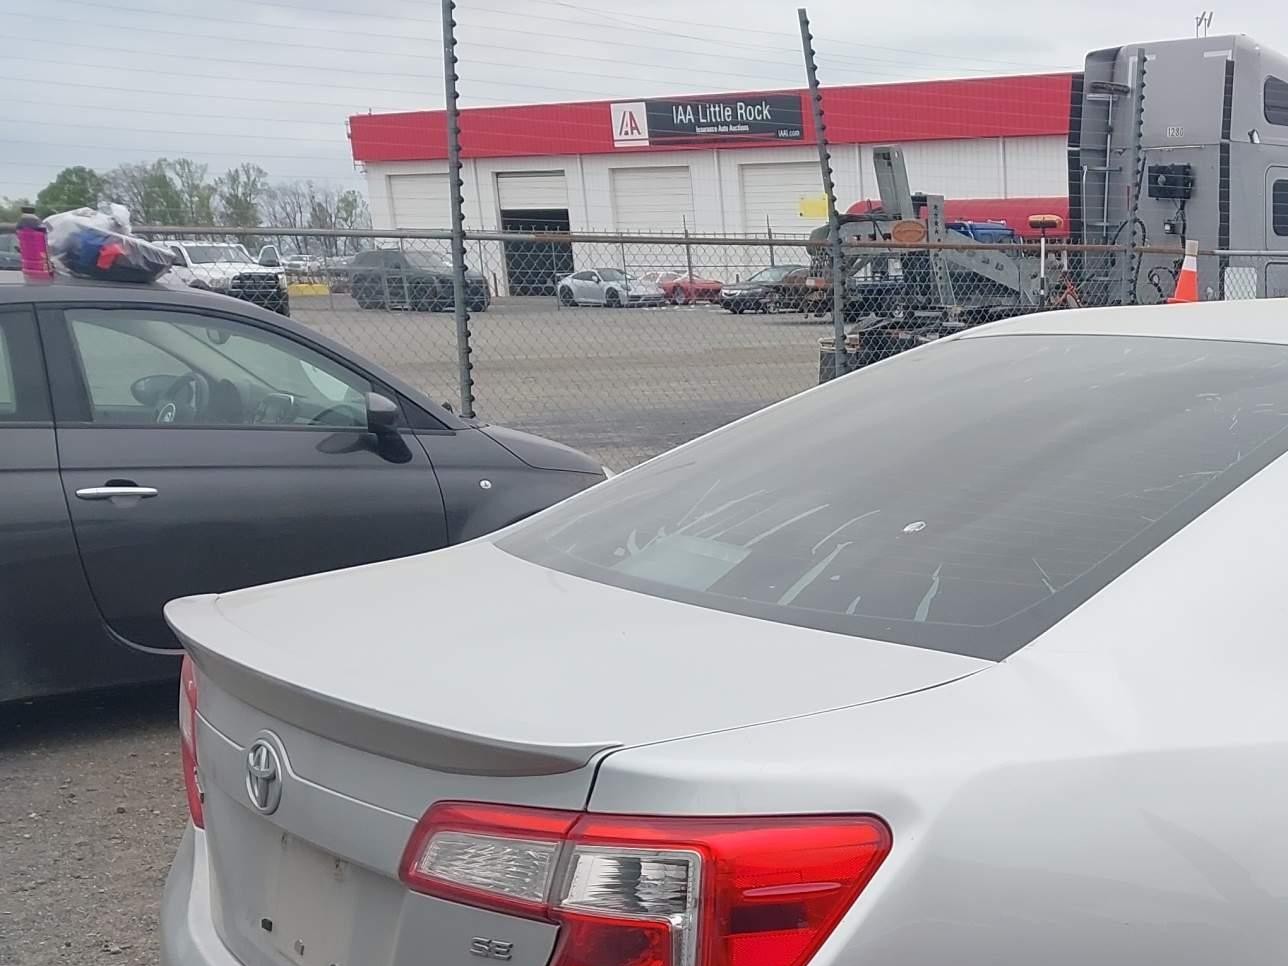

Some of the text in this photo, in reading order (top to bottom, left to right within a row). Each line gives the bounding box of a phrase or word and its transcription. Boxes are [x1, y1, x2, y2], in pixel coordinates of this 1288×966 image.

[673, 101, 771, 124] IAA Little Rock
[718, 124, 728, 132] Auto
[729, 123, 749, 131] Auctions
[470, 936, 513, 961] SE
